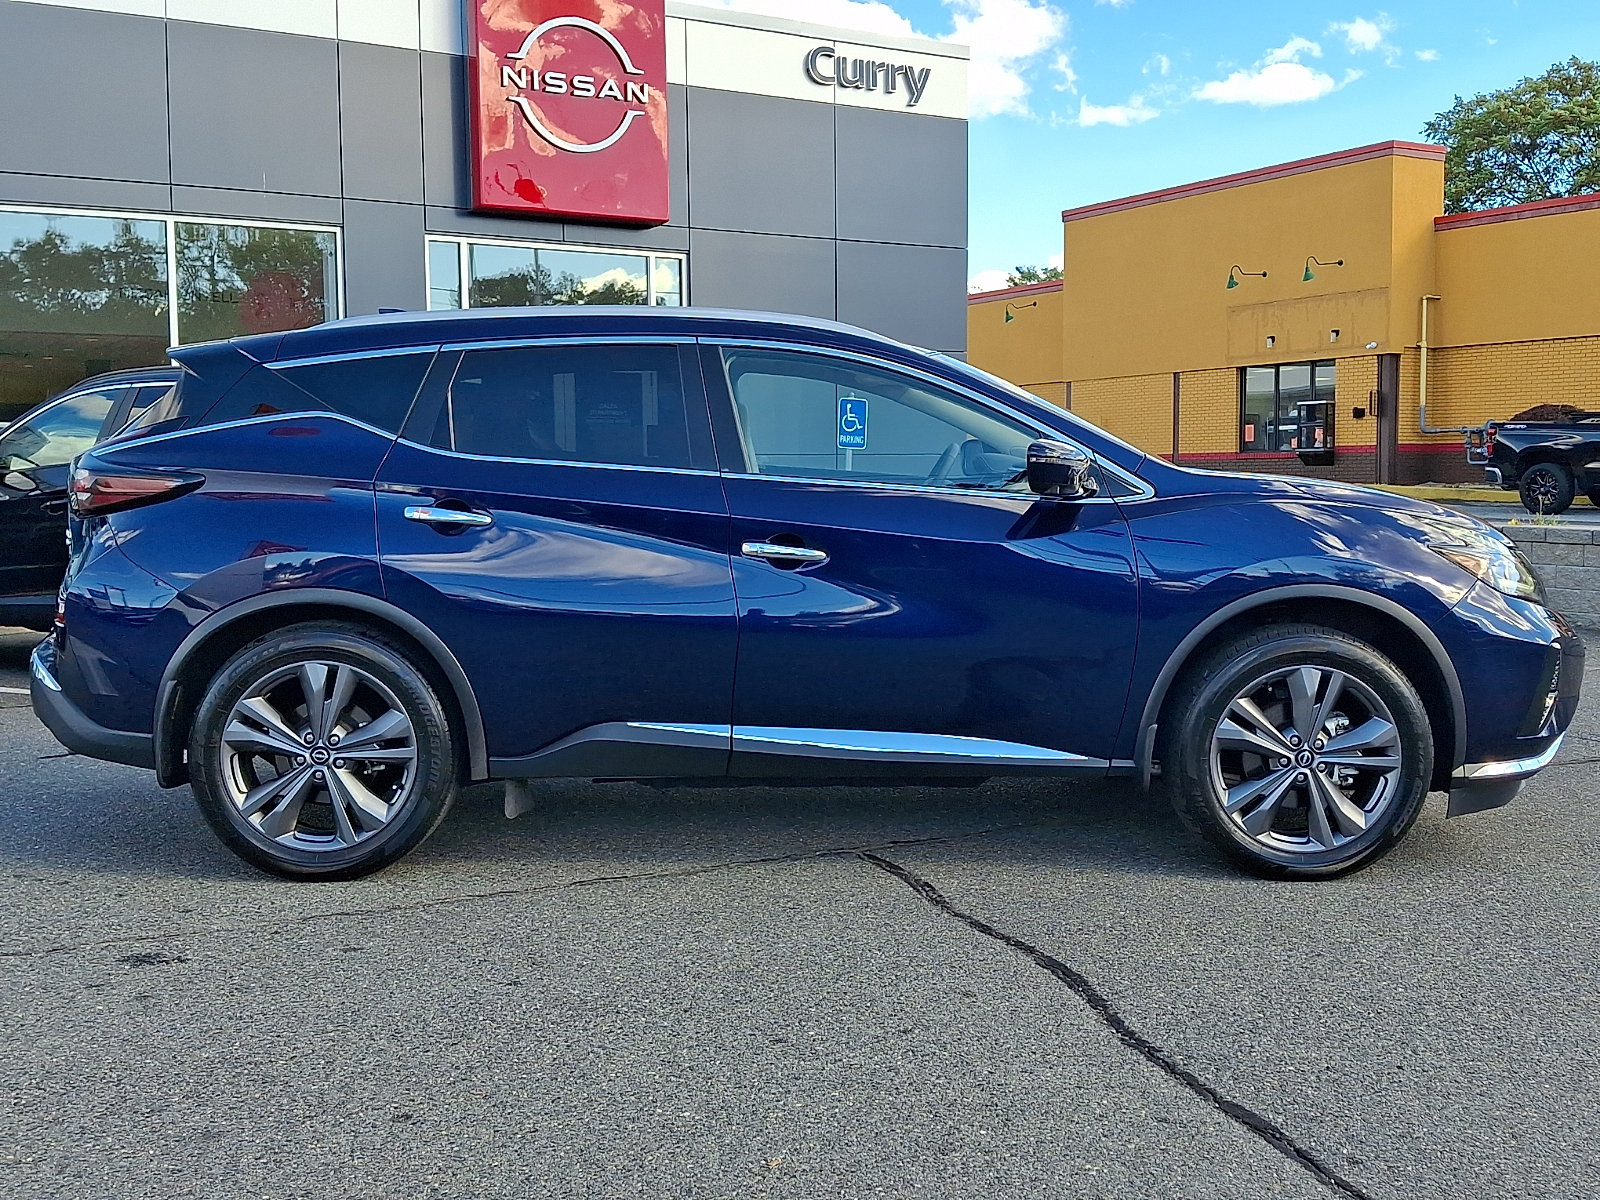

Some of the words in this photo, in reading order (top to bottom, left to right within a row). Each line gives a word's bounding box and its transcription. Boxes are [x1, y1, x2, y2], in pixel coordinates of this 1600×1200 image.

[501, 65, 649, 104] NISSAN
[803, 46, 931, 106] Curry
[839, 434, 864, 444] PARKING
